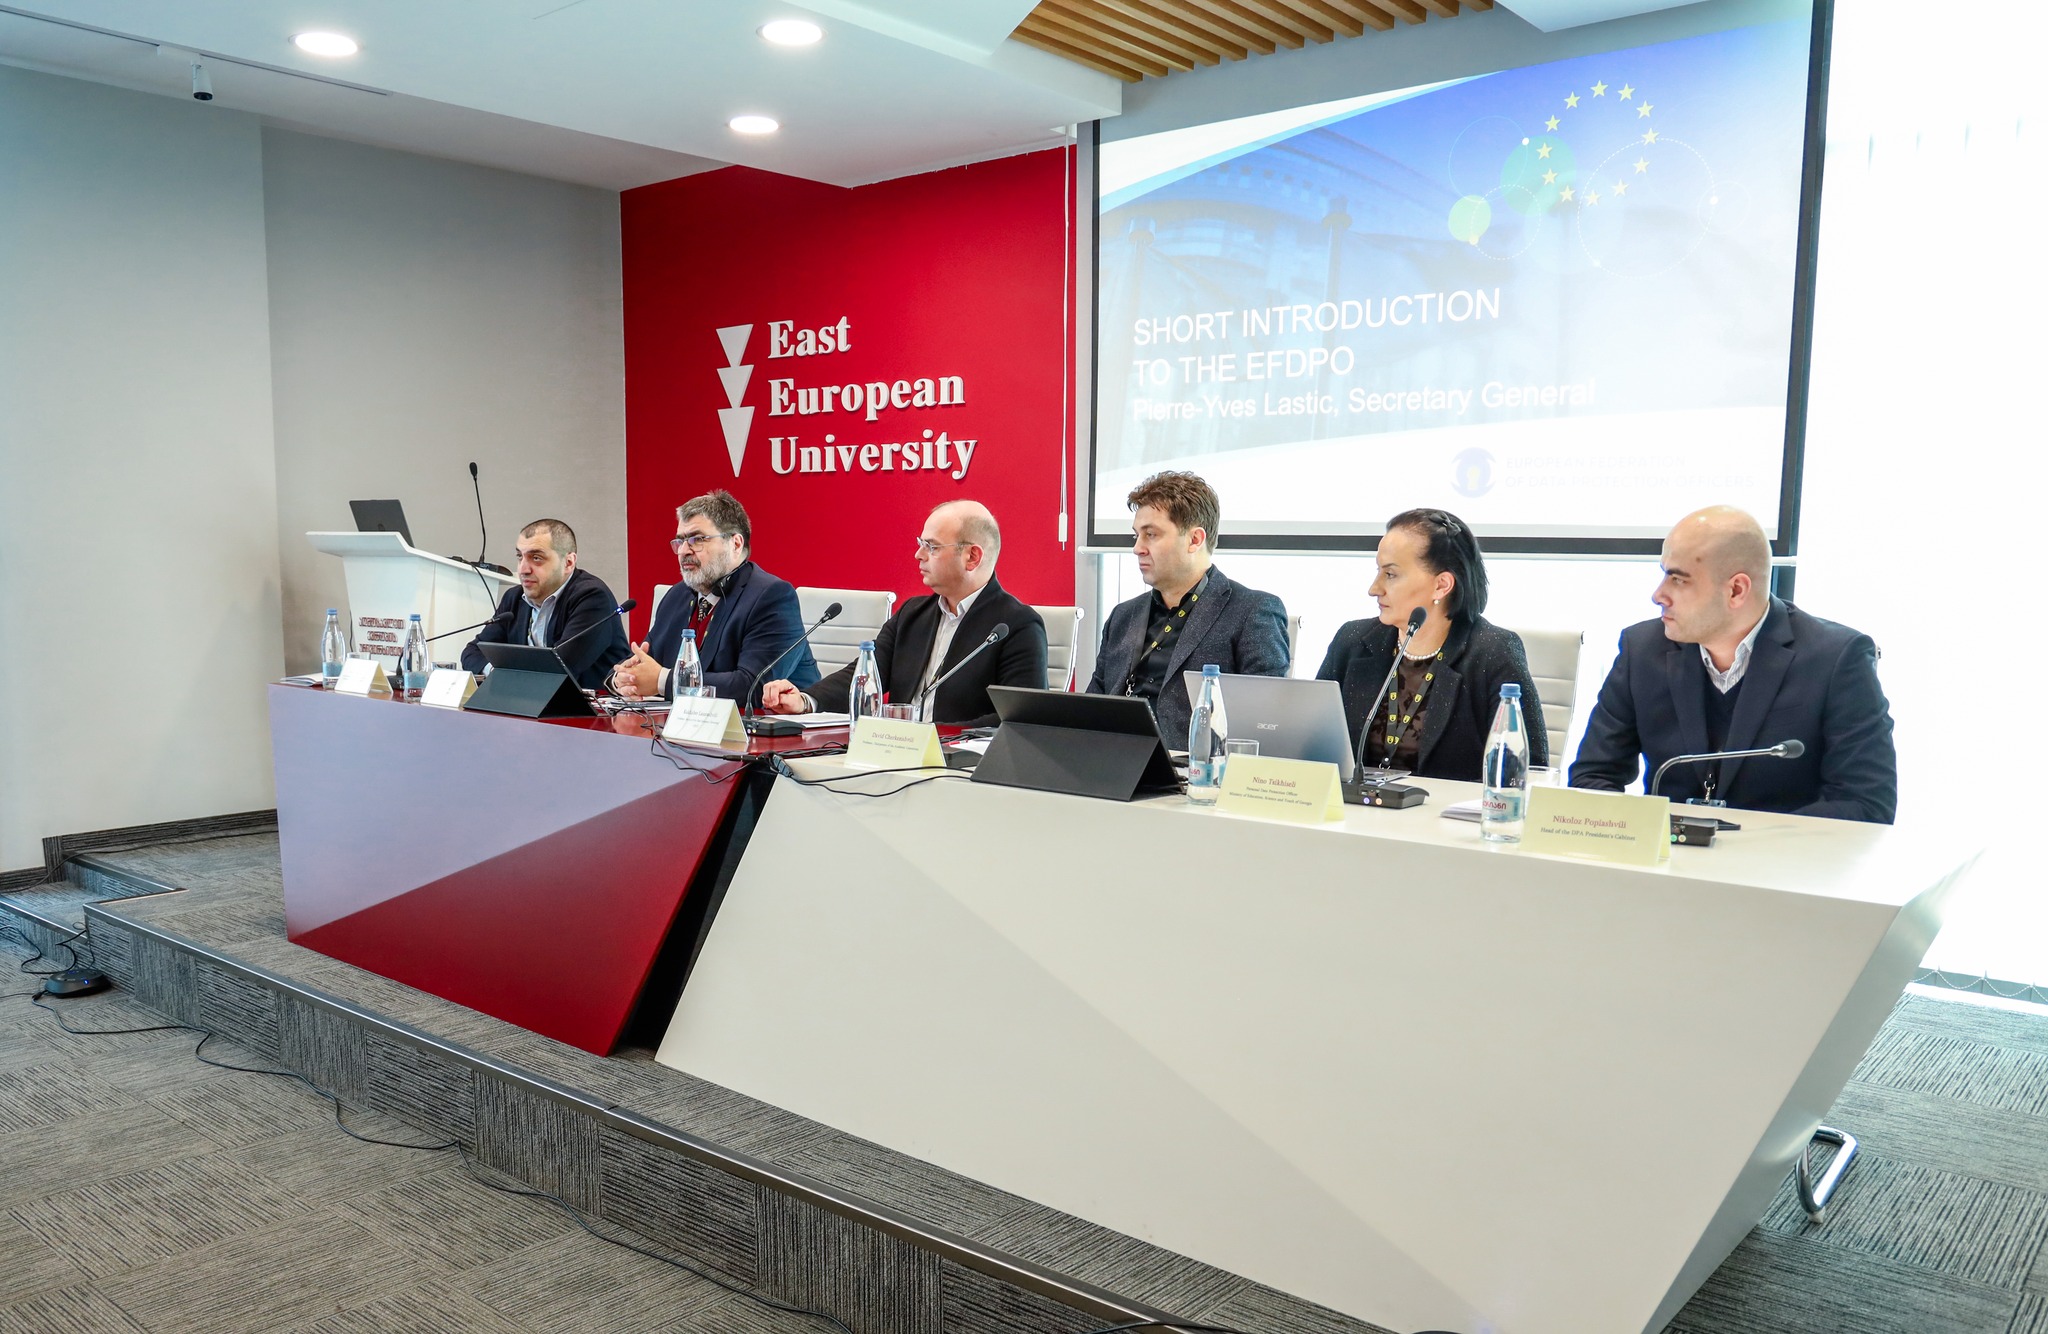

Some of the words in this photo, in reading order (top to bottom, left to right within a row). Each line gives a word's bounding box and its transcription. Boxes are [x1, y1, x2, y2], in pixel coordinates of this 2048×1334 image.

[1133, 311, 1233, 346] SHORT
[1243, 287, 1501, 337] INTRODUCTION
[767, 316, 852, 359] East
[1133, 357, 1171, 386] TO
[1179, 354, 1236, 385] THE
[1246, 345, 1355, 381] EFDPO
[767, 374, 966, 422] European
[1133, 391, 1256, 422] Pierre-Yves
[1263, 386, 1339, 421] Lastic,
[1347, 384, 1473, 417] Secretary
[1481, 377, 1596, 408] General
[768, 428, 978, 480] University
[1506, 456, 1585, 469] EUROPEAN
[1589, 455, 1686, 469] FEDERATION
[1505, 475, 1524, 489] OF
[1528, 475, 1566, 489] DATA
[1571, 475, 1670, 489] PROTECTION
[1257, 722, 1279, 731] acer
[1252, 776, 1267, 784] Nino
[1552, 815, 1582, 825] Nikoloz
[1614, 833, 1636, 841] Cabinet
